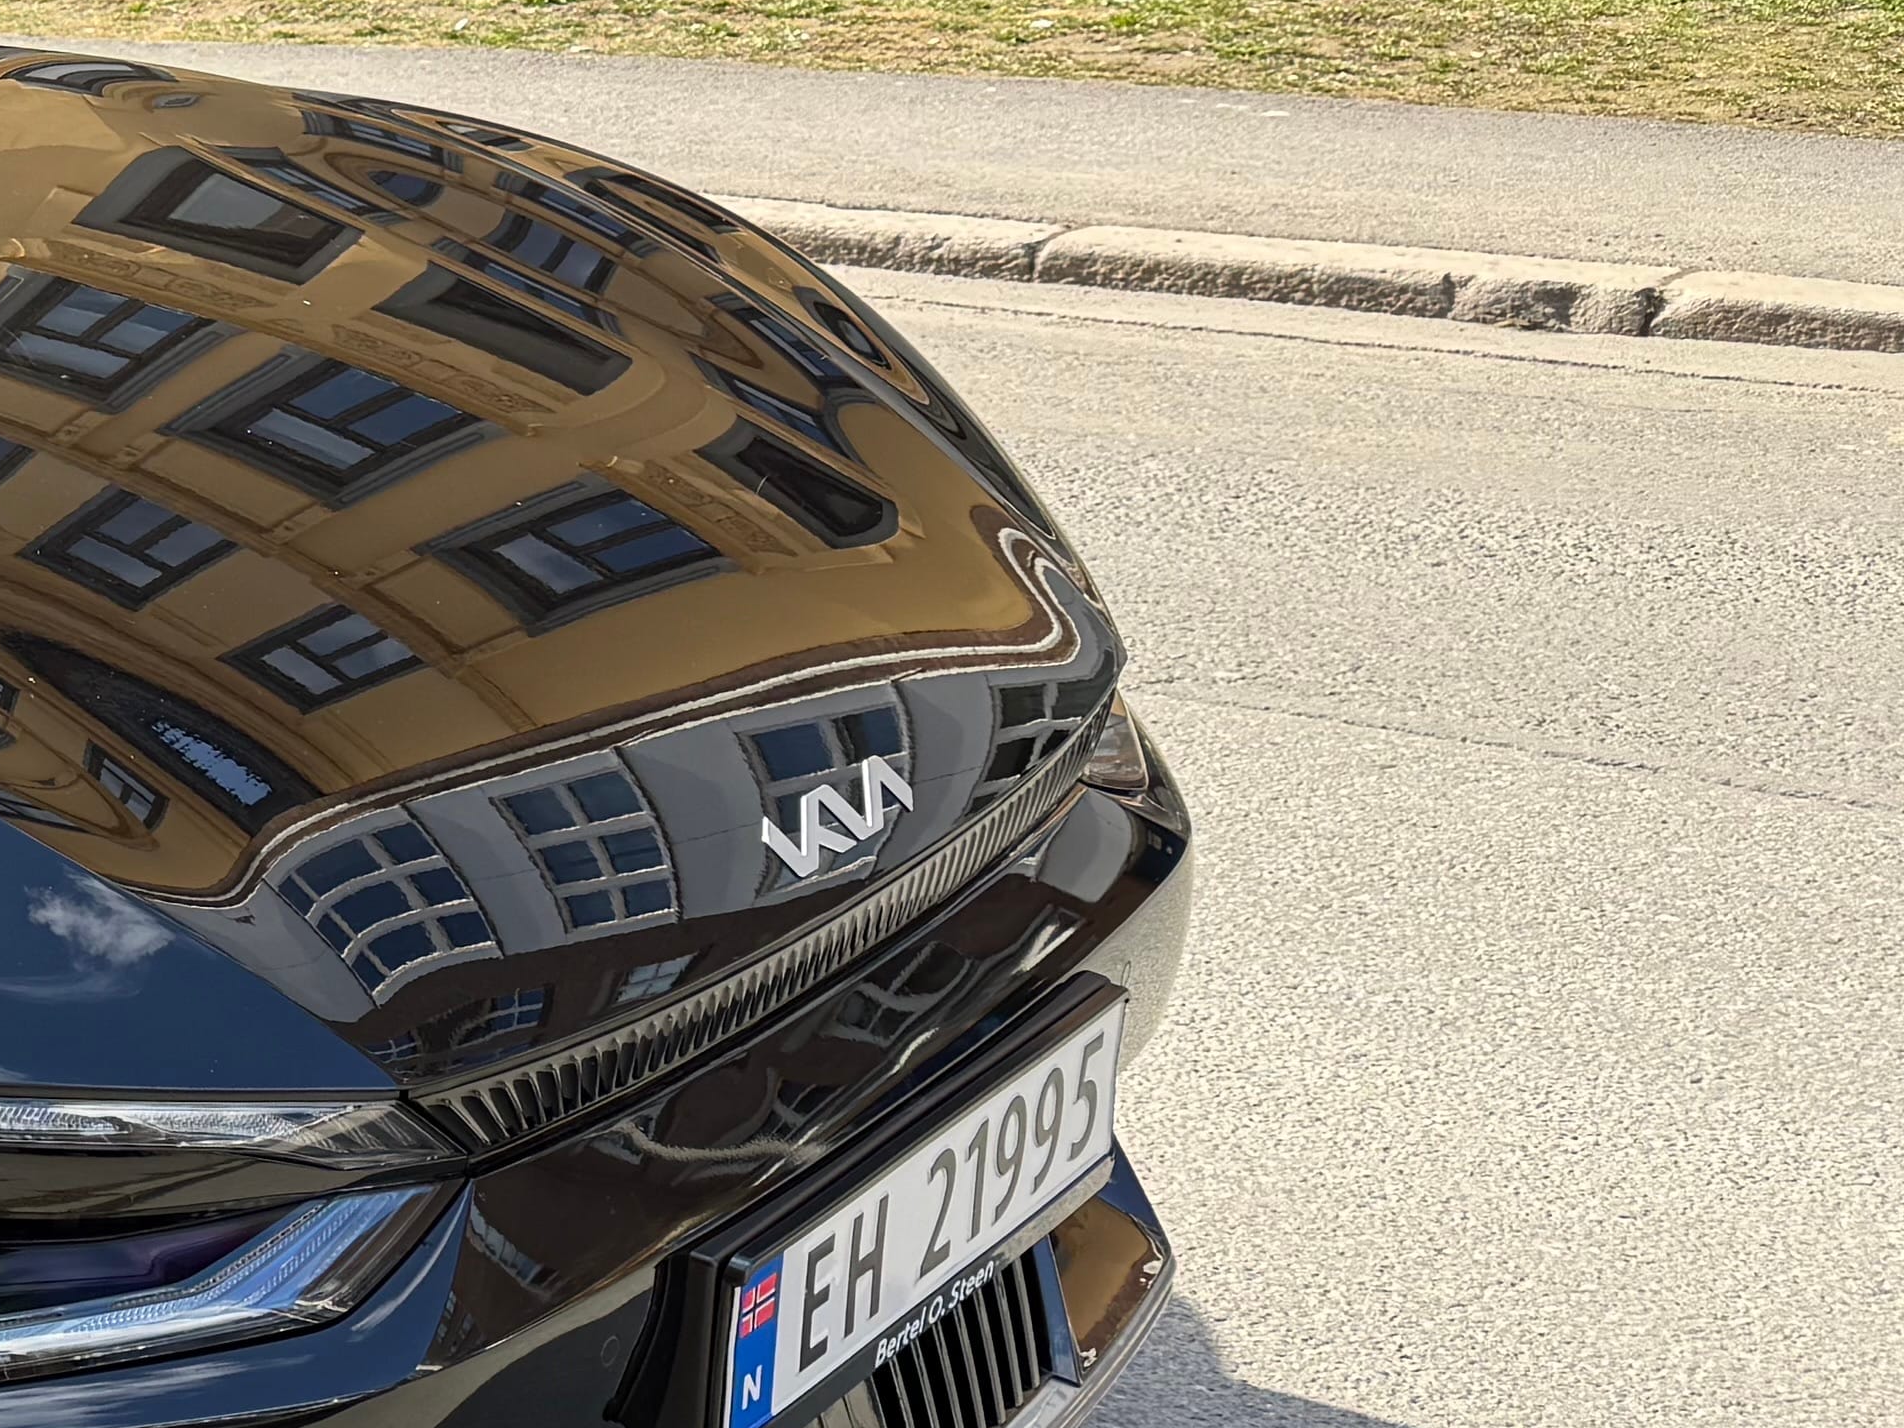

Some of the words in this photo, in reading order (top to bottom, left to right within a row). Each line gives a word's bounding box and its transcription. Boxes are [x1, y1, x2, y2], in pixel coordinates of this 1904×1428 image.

[762, 755, 914, 877] KIA
[798, 1194, 890, 1373] EH
[919, 1031, 1104, 1279] 21995
[875, 1305, 927, 1369] Bertel
[928, 1295, 946, 1325] O.
[948, 1260, 994, 1309] Steen
[740, 1365, 764, 1410] N
